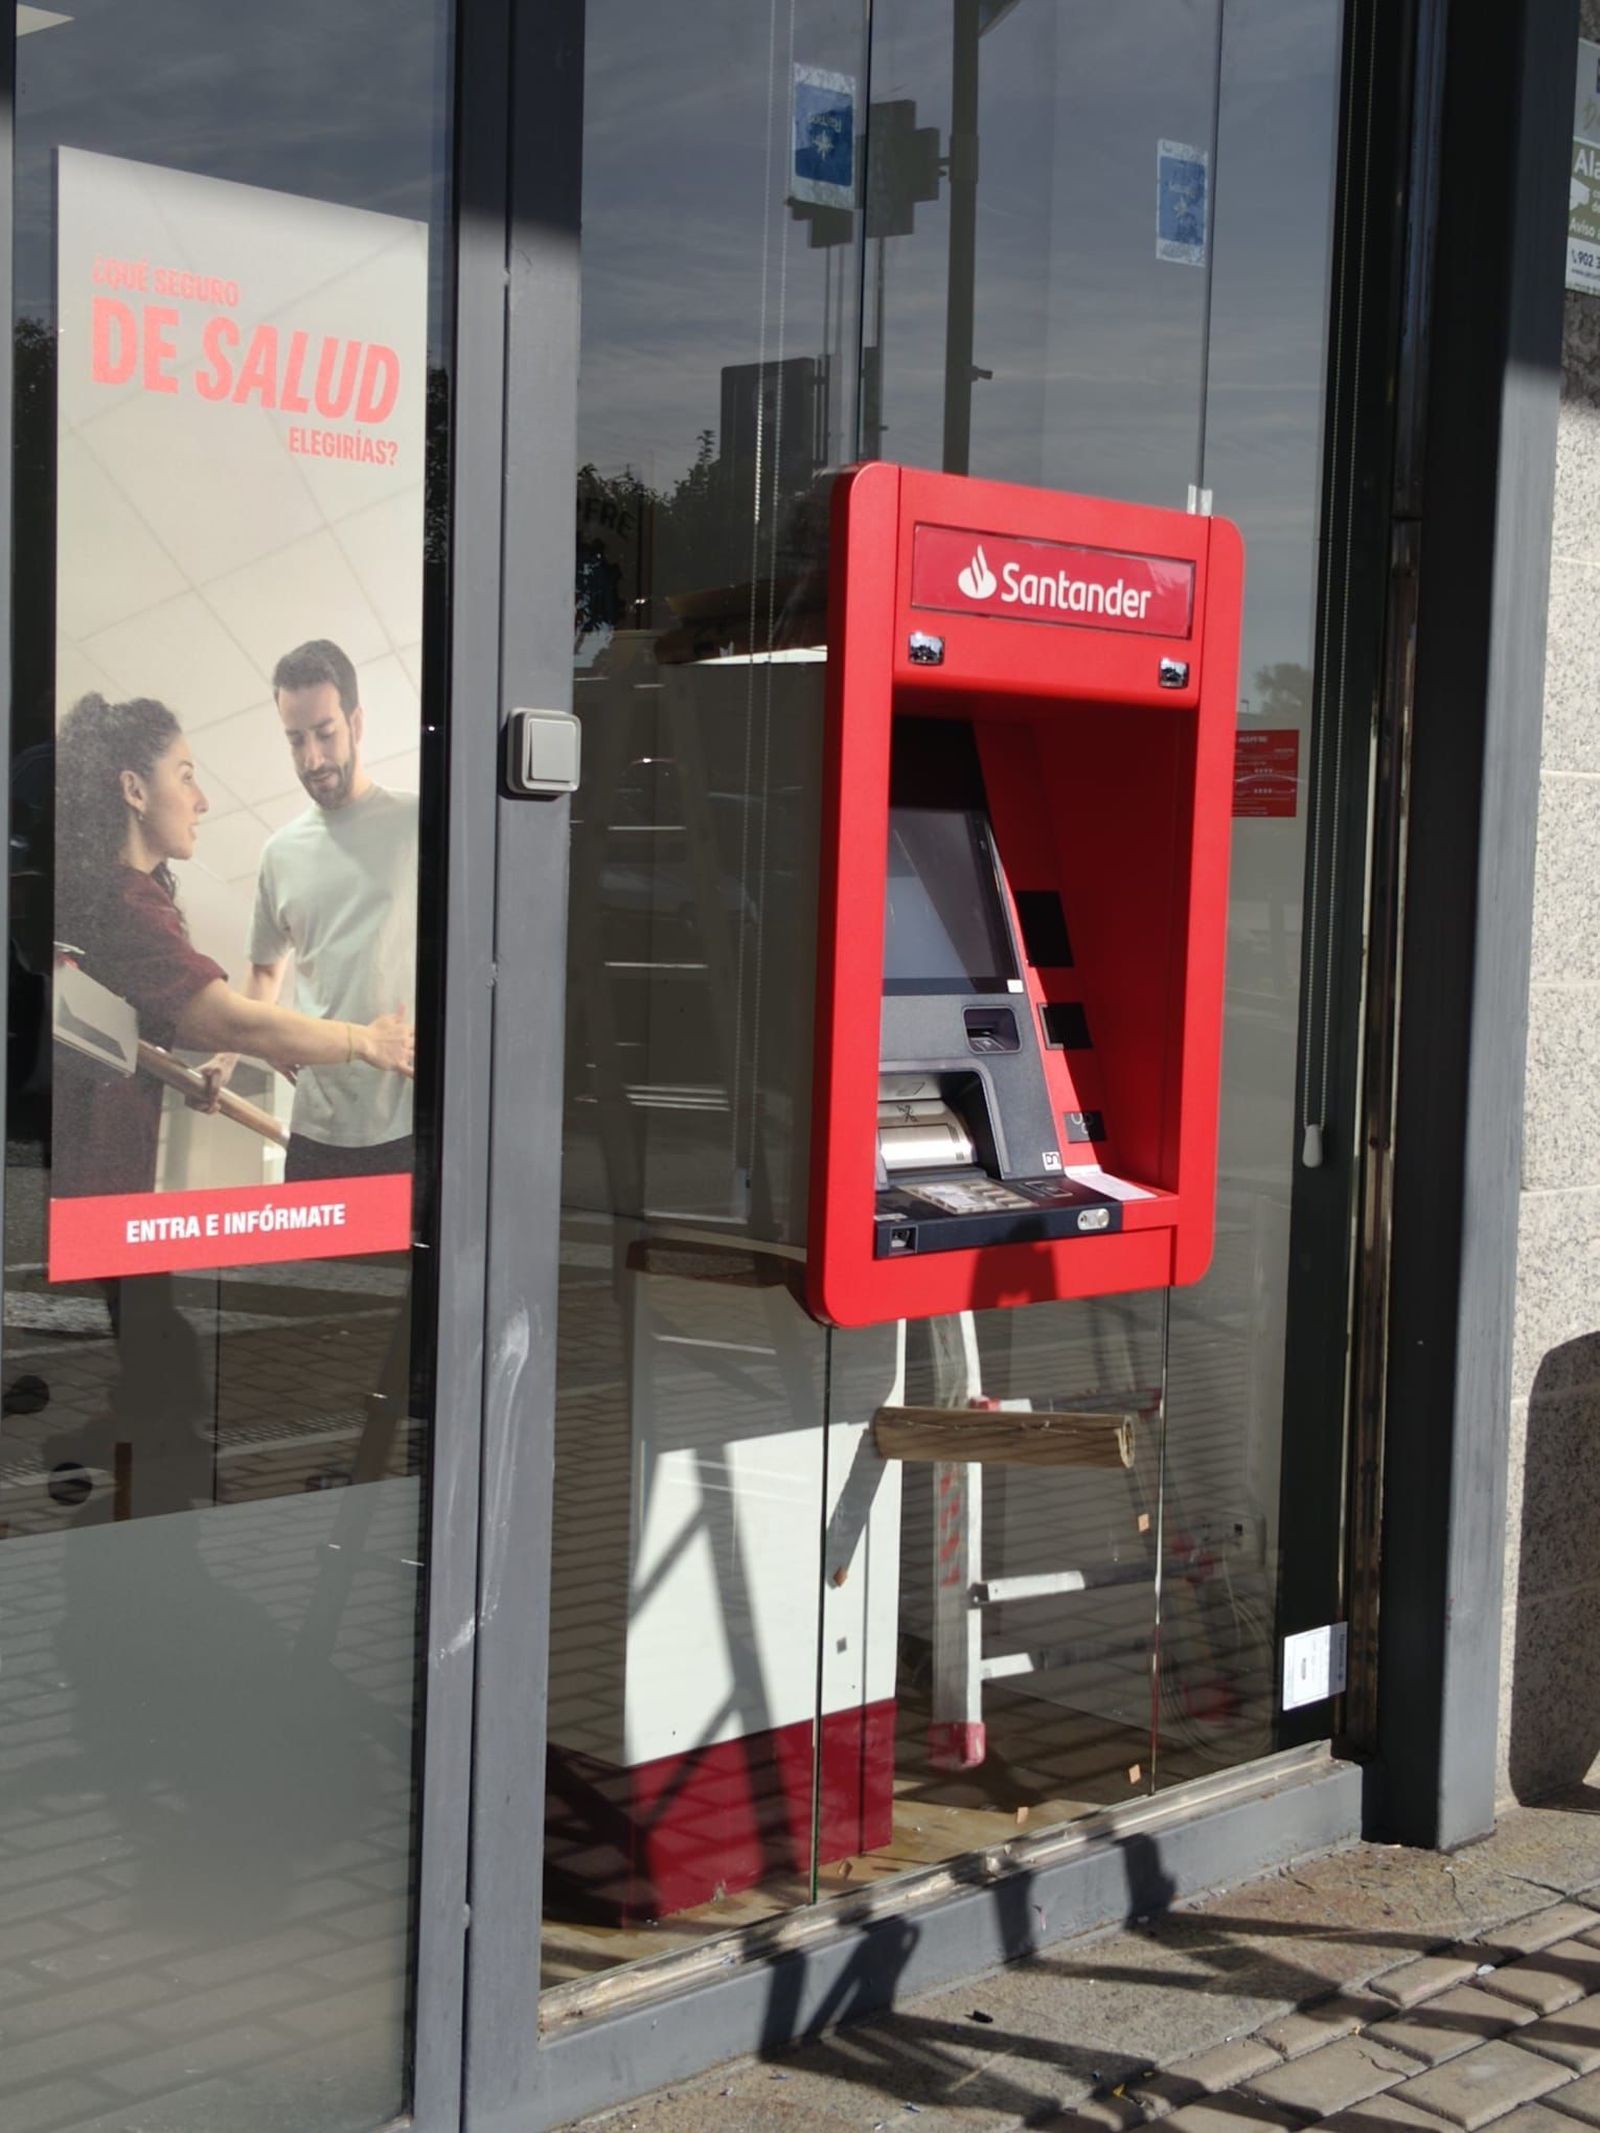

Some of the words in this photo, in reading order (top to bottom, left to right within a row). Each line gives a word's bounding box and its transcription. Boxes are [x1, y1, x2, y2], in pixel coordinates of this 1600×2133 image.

[92, 256, 148, 293] ¿QUÉ
[154, 268, 240, 308] SEGURO
[1578, 250, 1594, 268] 902
[92, 296, 180, 394] DE
[195, 316, 400, 424] SALUD
[288, 426, 398, 466] ELEGIRÍAS?
[1001, 562, 1152, 619] Santander
[126, 1215, 200, 1244] ENTRA
[206, 1214, 219, 1236] E
[223, 1203, 346, 1235] INFÓRMATE
